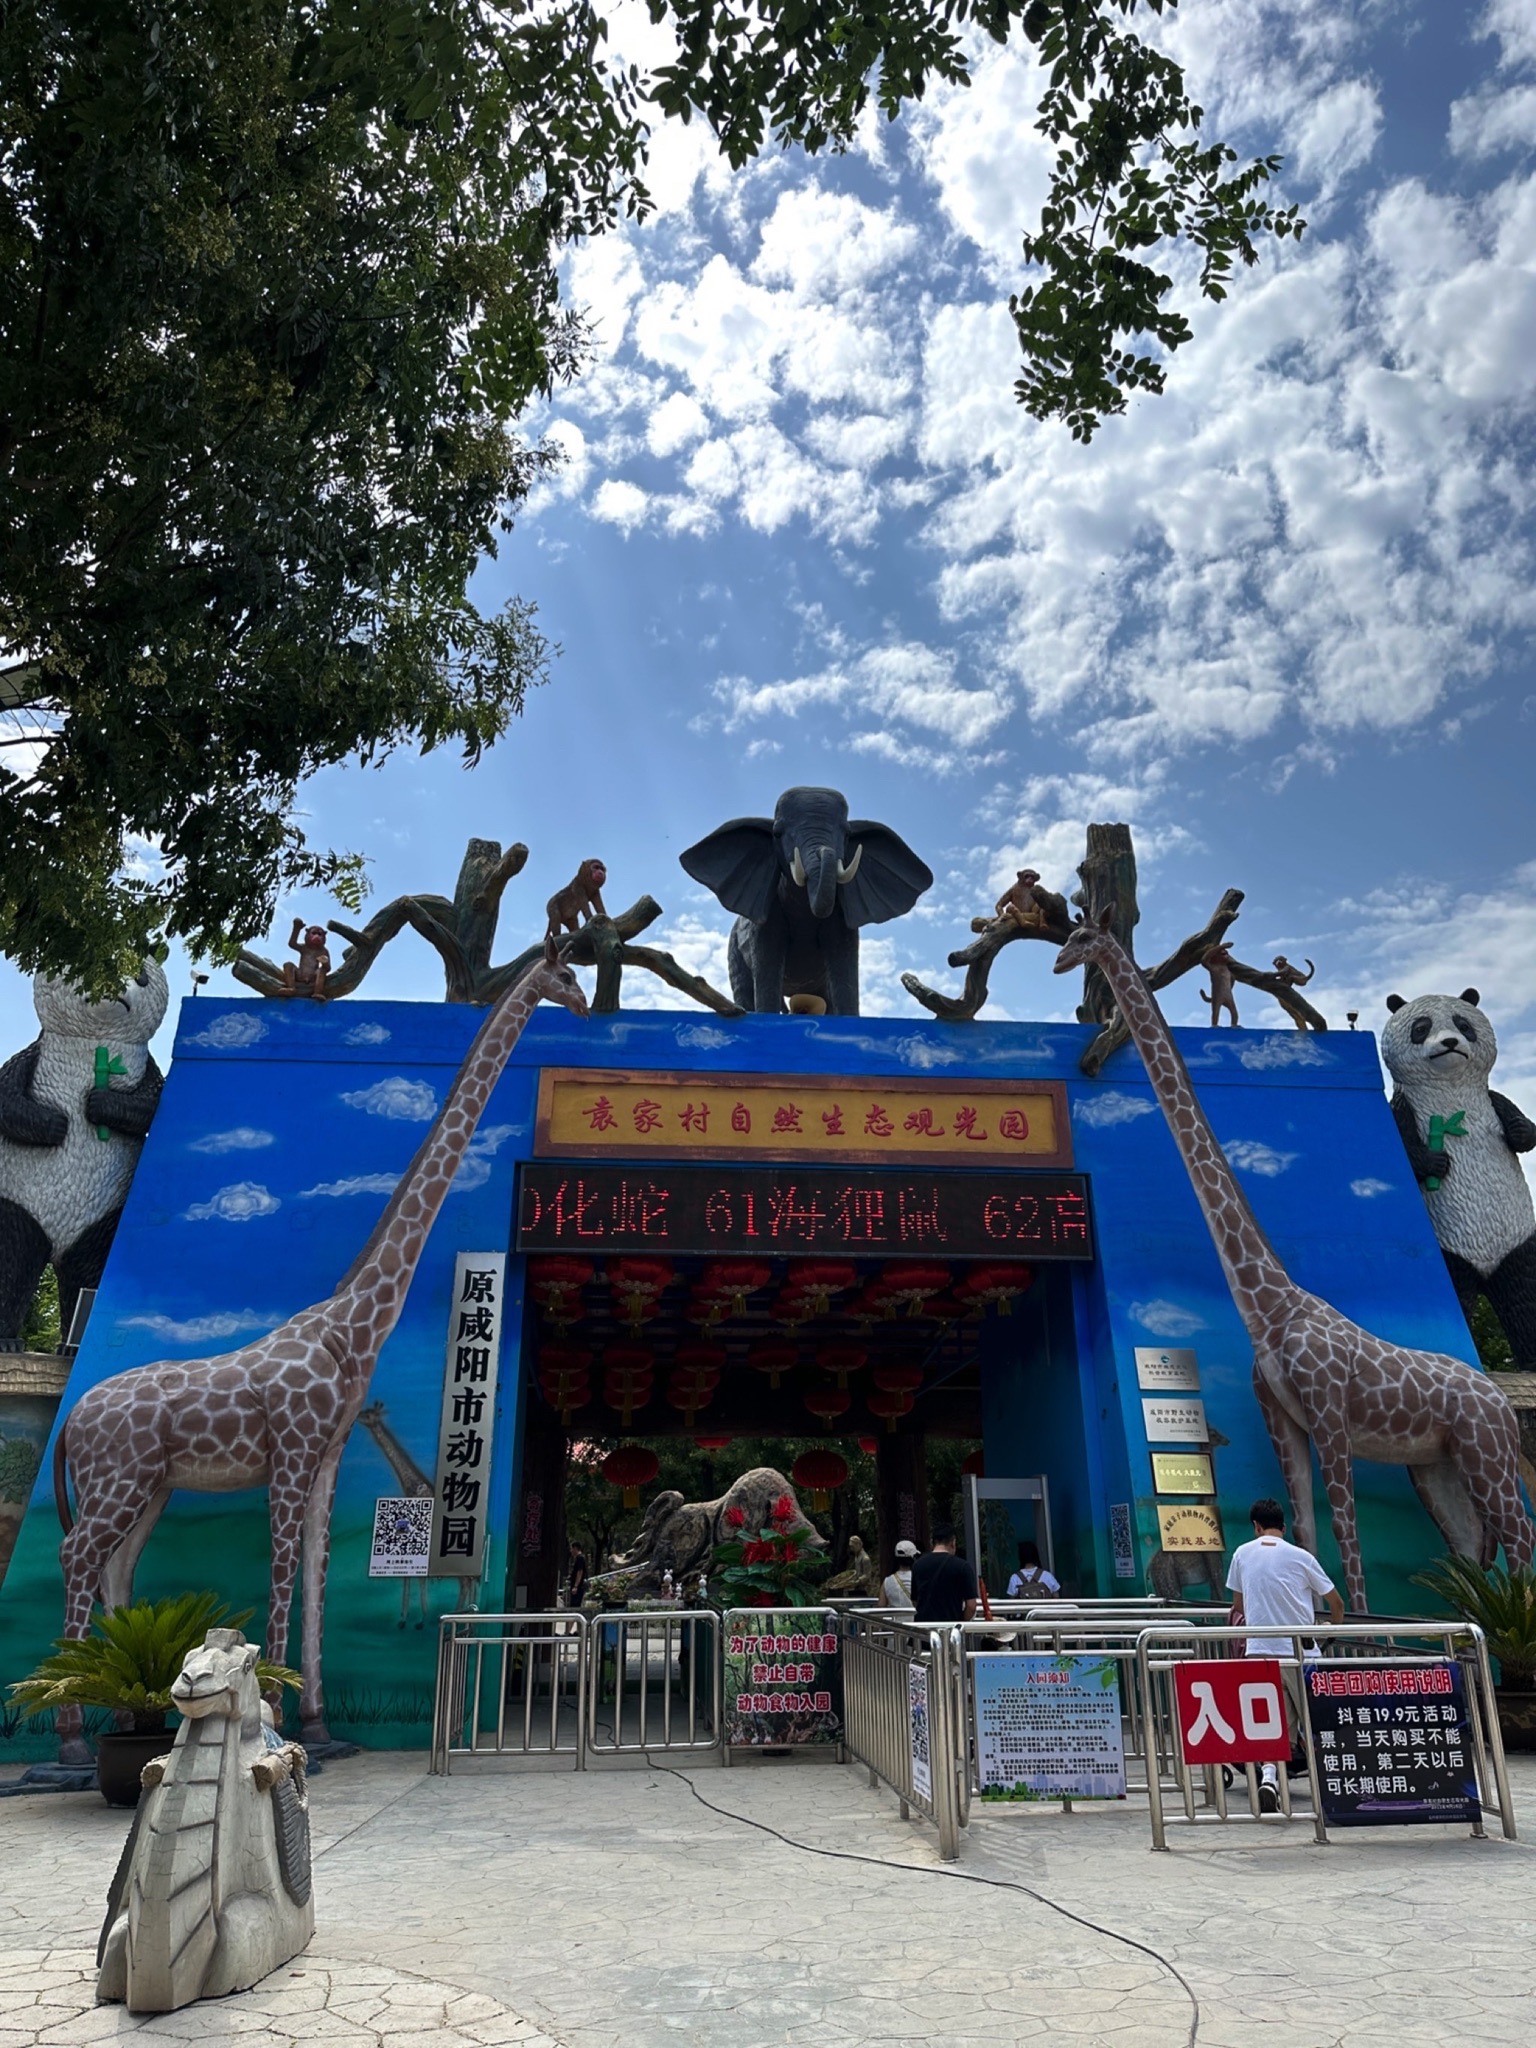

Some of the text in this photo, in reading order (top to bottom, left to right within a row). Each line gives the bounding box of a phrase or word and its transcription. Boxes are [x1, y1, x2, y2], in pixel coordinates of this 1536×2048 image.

[582, 1095, 1031, 1141] 袁家村自然生态观光园
[439, 1268, 498, 1558] 原咸阳市动物园
[1167, 1535, 1220, 1546] 实践基地
[730, 1634, 837, 1655] 为了动物的健康
[752, 1663, 815, 1683] 禁止自带
[1310, 1668, 1453, 1697] 抖音团购使用说明
[736, 1692, 831, 1713] 动物食物入园
[1187, 1681, 1283, 1746] 入口
[1337, 1704, 1458, 1725] 抖音19.9元活动
[1320, 1727, 1462, 1750] 票，当天购买不能
[1323, 1750, 1465, 1773] 使用，第二天以后
[1326, 1774, 1417, 1797] 可长期使用。
